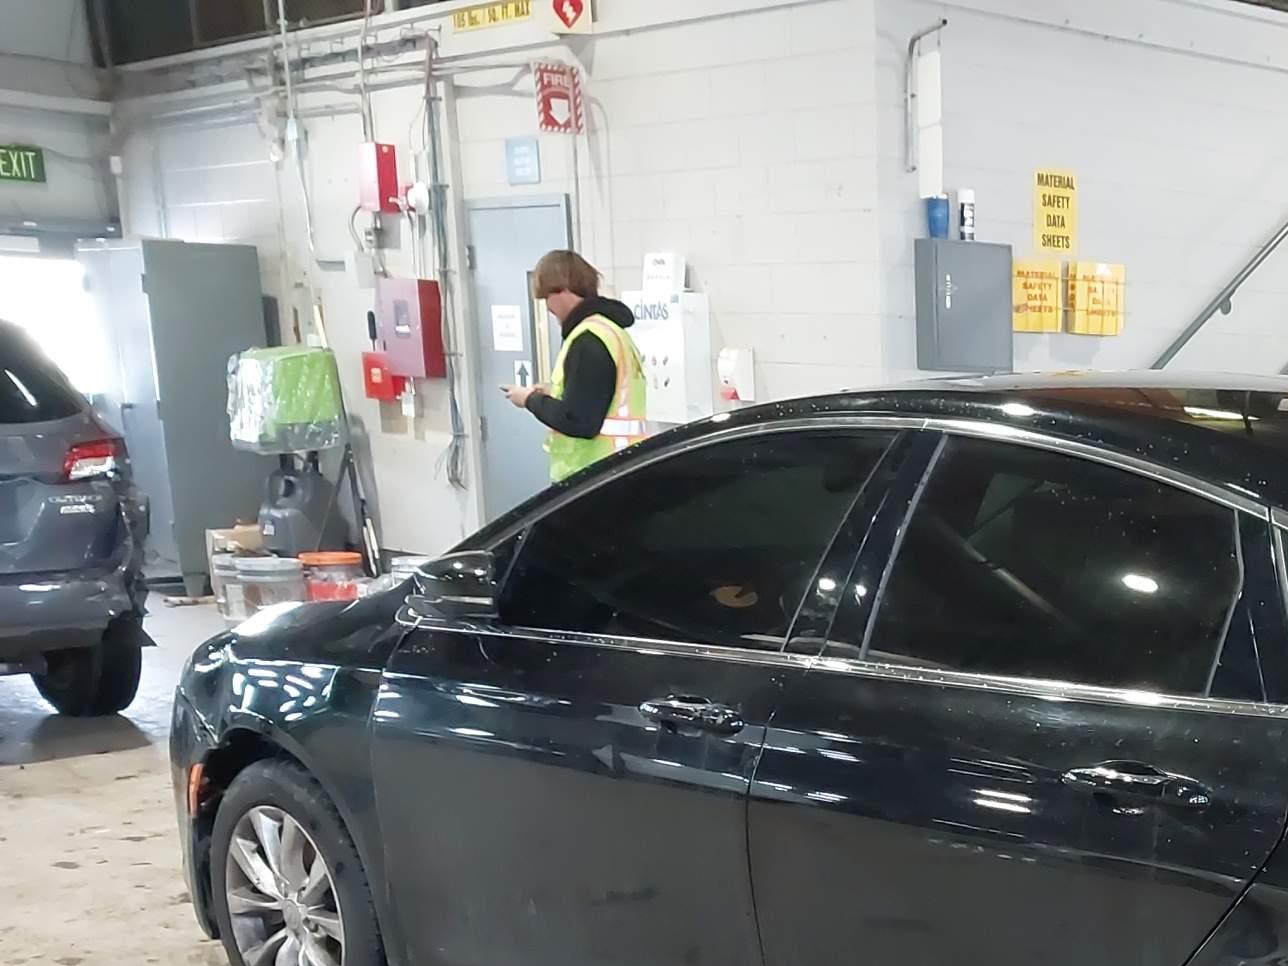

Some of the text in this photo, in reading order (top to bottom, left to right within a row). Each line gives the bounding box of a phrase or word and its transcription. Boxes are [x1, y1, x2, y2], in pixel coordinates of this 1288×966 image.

[543, 72, 571, 87] FIRE
[0, 149, 36, 179] EXIT
[1037, 172, 1075, 190] MATERIAL
[1042, 193, 1071, 209] SAFETY
[1046, 214, 1065, 228] DATA
[1042, 234, 1070, 249] SHEETS
[634, 299, 669, 320] CINTAS
